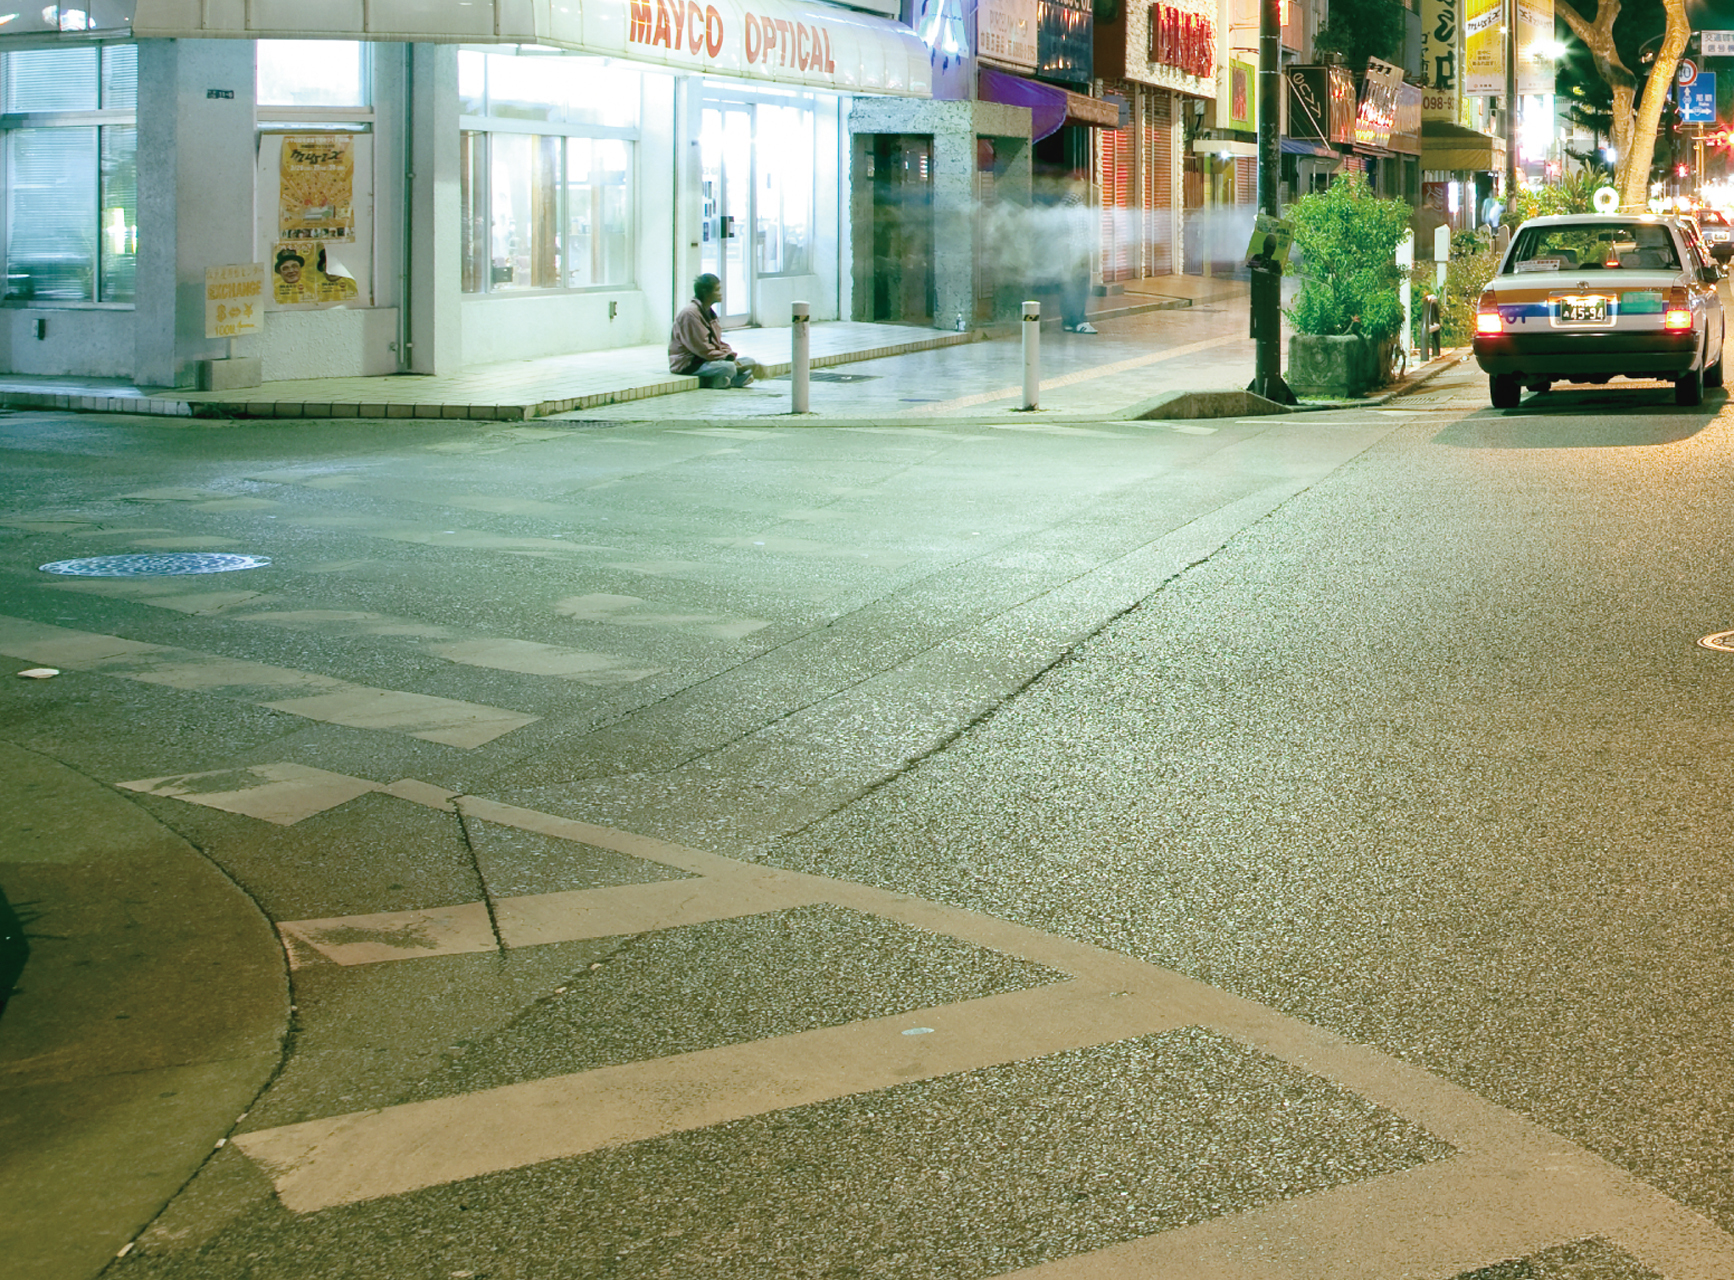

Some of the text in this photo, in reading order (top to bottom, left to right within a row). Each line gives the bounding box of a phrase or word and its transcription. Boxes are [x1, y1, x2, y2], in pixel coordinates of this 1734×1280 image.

[744, 11, 836, 75] OPTICAL
[208, 281, 262, 300] EXCHANGE
[1570, 307, 1604, 320] 45-94
